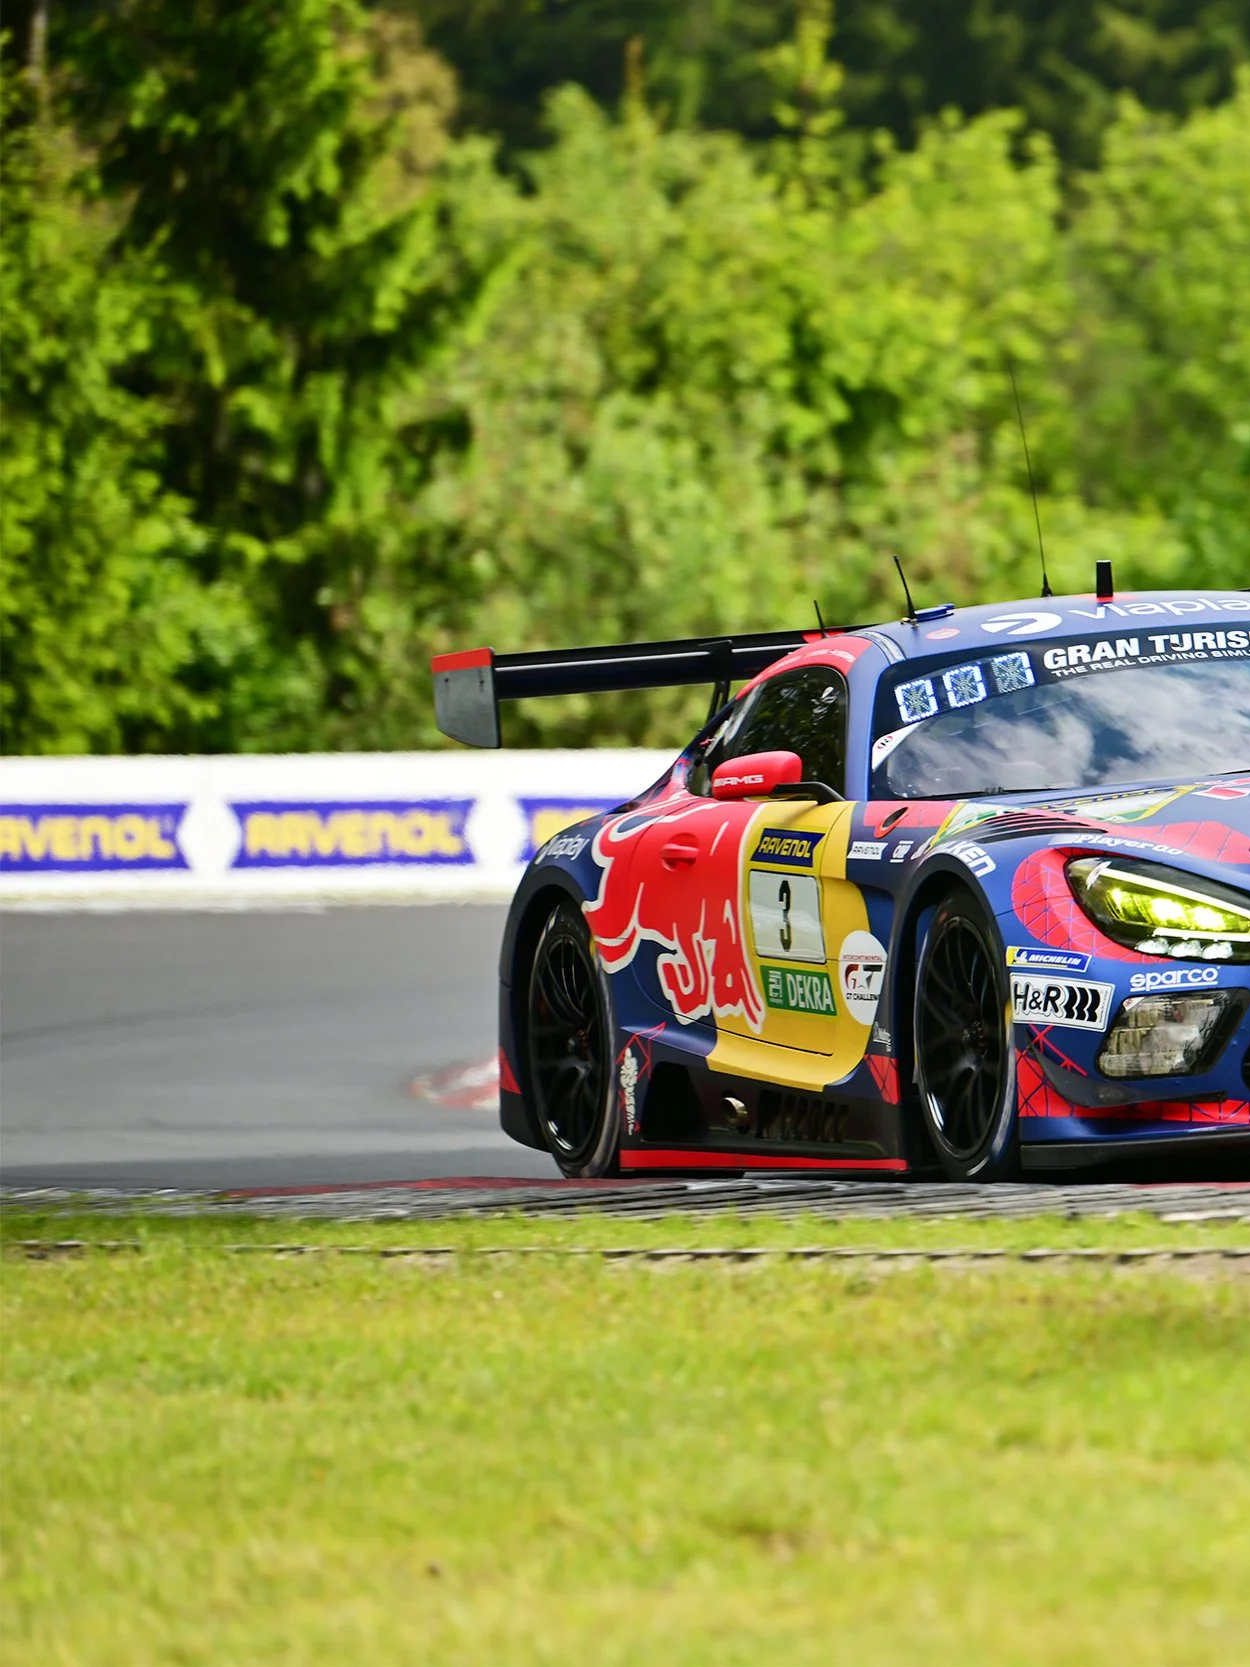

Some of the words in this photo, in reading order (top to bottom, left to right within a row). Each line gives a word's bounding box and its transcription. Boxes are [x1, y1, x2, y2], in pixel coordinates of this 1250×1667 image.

[1043, 637, 1139, 670] GRAN
[1051, 667, 1088, 678] THE
[1091, 659, 1136, 672] REAL
[1138, 650, 1209, 663] DRIVING
[722, 774, 764, 786] AMG
[0, 813, 176, 861] AVENOL
[245, 809, 463, 857] RAVENOL
[757, 836, 813, 858] RAVENOL
[778, 880, 793, 952] 3
[1028, 954, 1082, 966] MICHELIN
[785, 973, 835, 1012] DEKRA
[1130, 967, 1218, 991] sparco
[853, 993, 880, 1001] CHALLEN
[1013, 982, 1061, 1014] H&R
